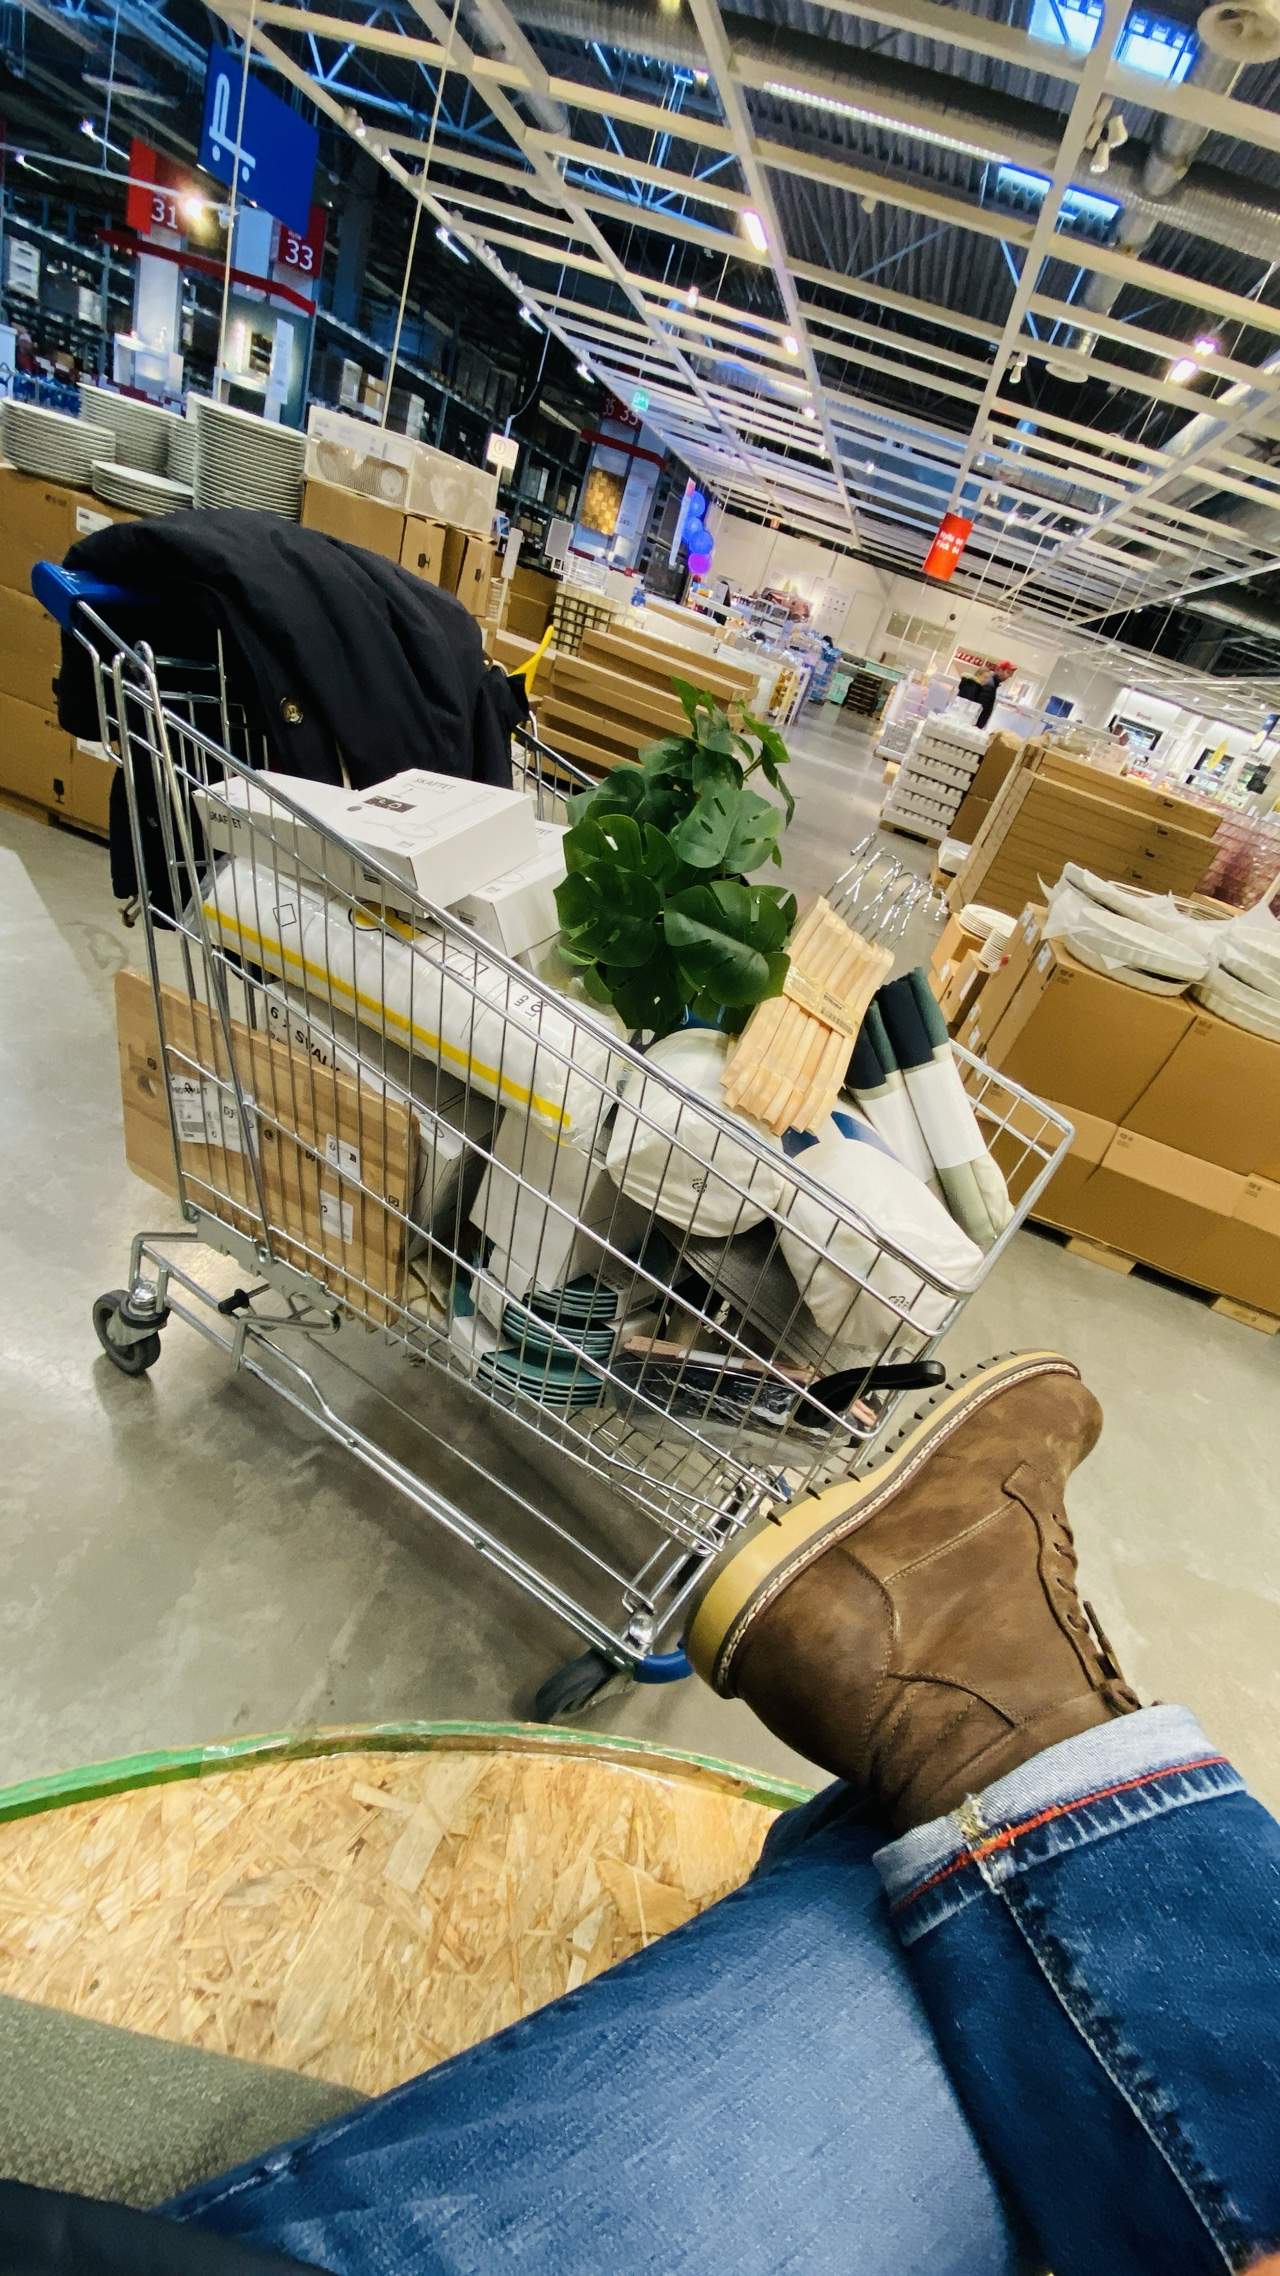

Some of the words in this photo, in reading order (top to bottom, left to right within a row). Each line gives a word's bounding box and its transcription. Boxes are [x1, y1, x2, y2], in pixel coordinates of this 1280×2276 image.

[151, 198, 178, 229] 31
[284, 239, 314, 271] 33
[208, 811, 242, 830] SKAFET
[270, 1006, 279, 1019] 6
